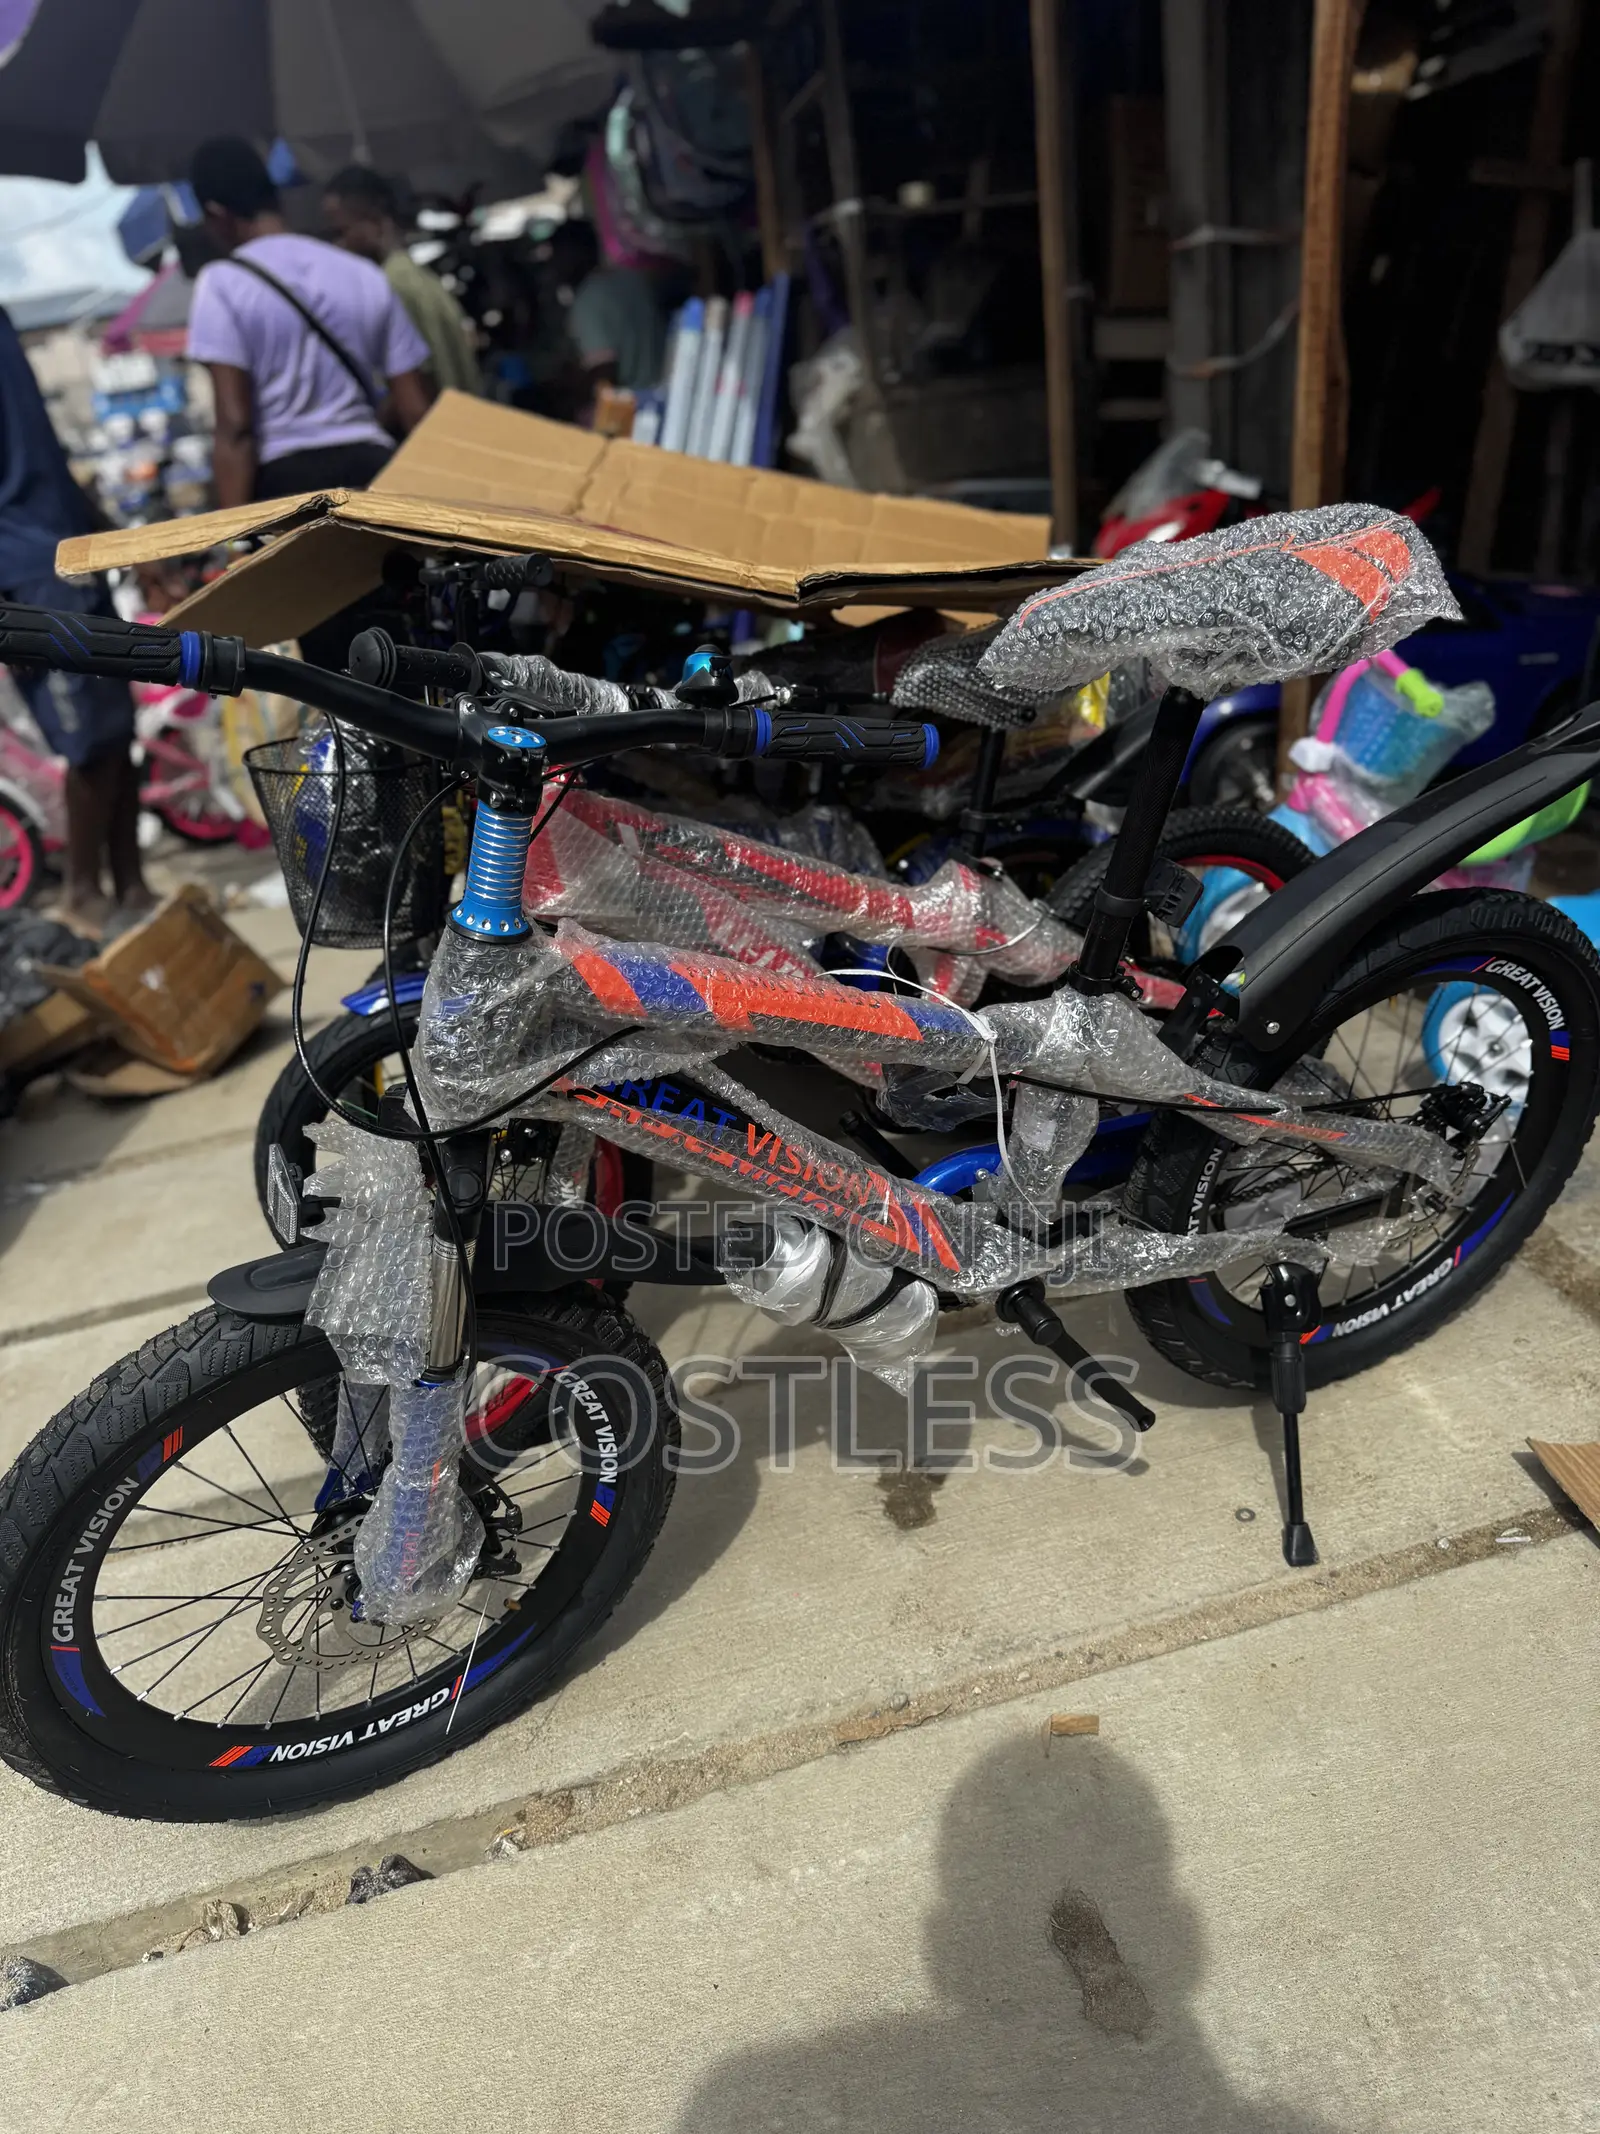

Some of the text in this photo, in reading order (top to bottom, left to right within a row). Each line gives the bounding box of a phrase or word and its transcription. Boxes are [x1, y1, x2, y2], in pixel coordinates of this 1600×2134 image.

[1484, 959, 1566, 1031] GREAT VISION
[745, 1122, 875, 1207] VISION
[1190, 1147, 1224, 1213] VISION
[1331, 1256, 1454, 1338] GREAT VISION
[553, 1371, 619, 1484] GREAT VISION
[51, 1558, 86, 1644] GREAT
[73, 1476, 141, 1556] VISION
[268, 1686, 451, 1763] GREAT VISION
